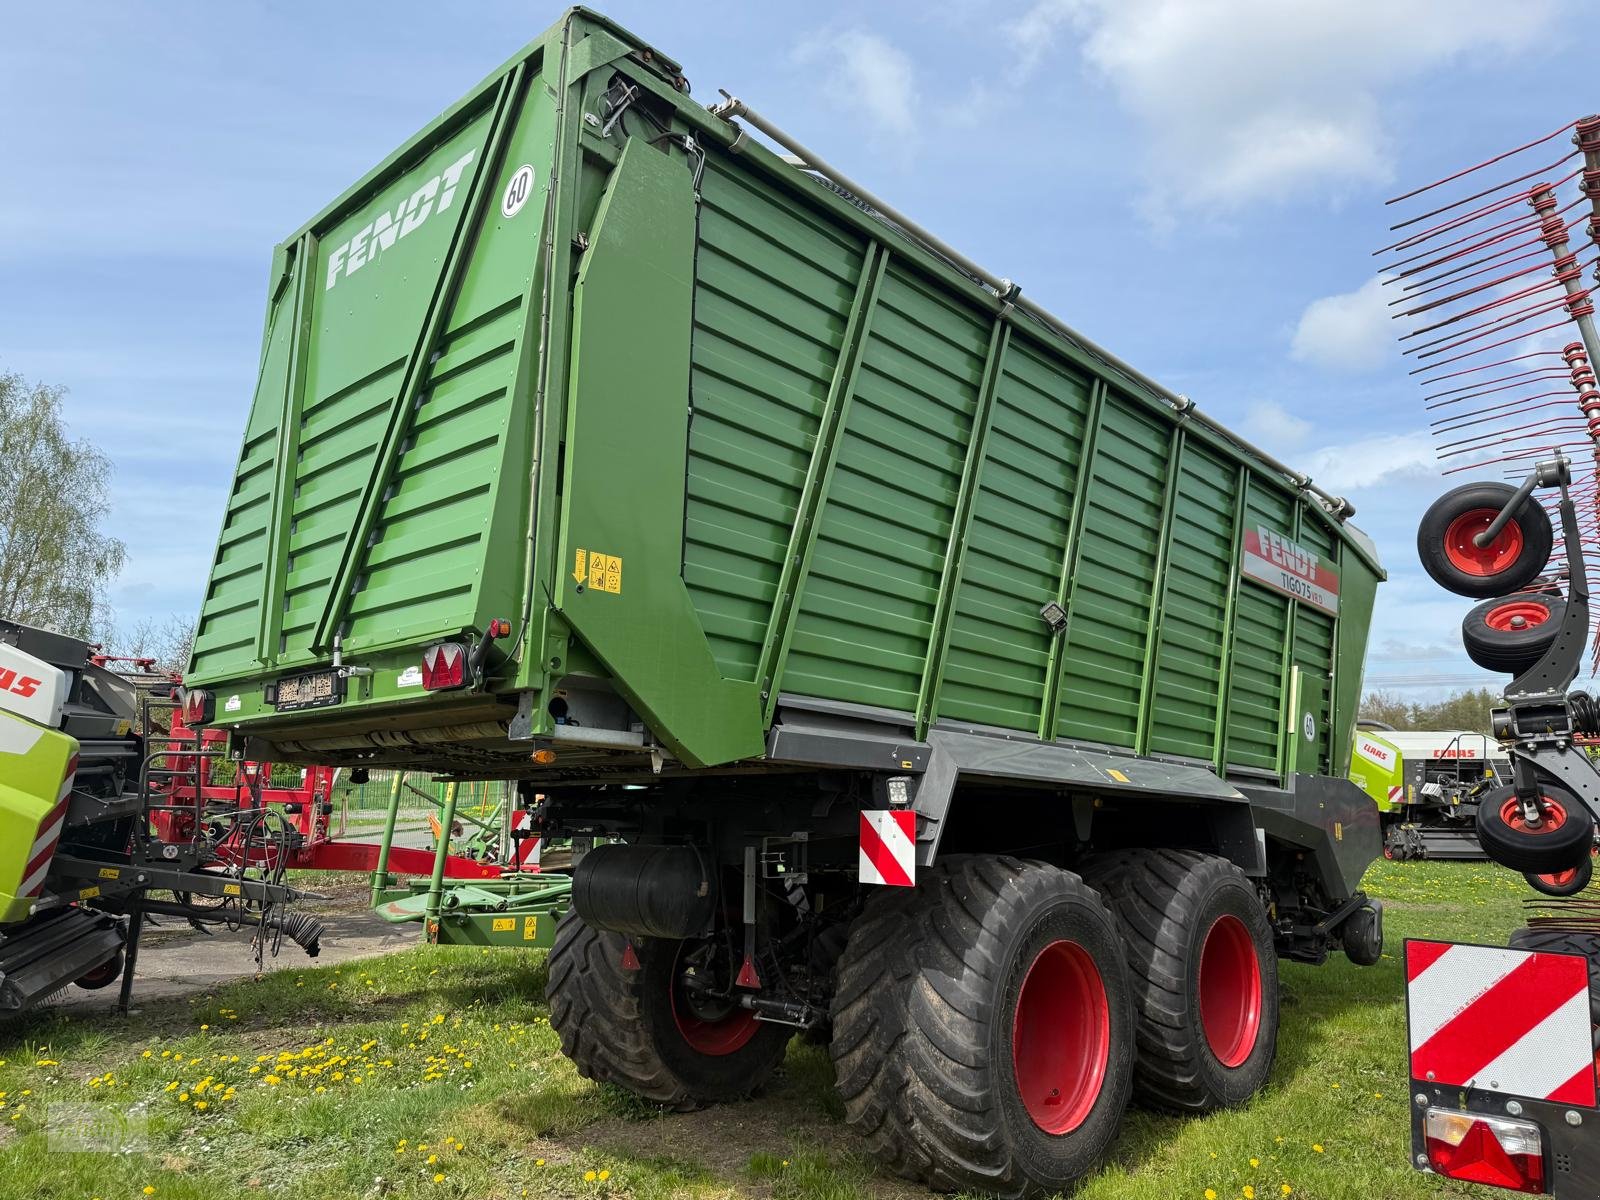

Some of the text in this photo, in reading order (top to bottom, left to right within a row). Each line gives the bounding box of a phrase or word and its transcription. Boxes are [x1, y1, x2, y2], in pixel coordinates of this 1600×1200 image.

[506, 171, 529, 210] 60
[325, 147, 478, 292] FENDT
[1256, 524, 1319, 581] FENDT
[1363, 743, 1388, 760] CLAAS
